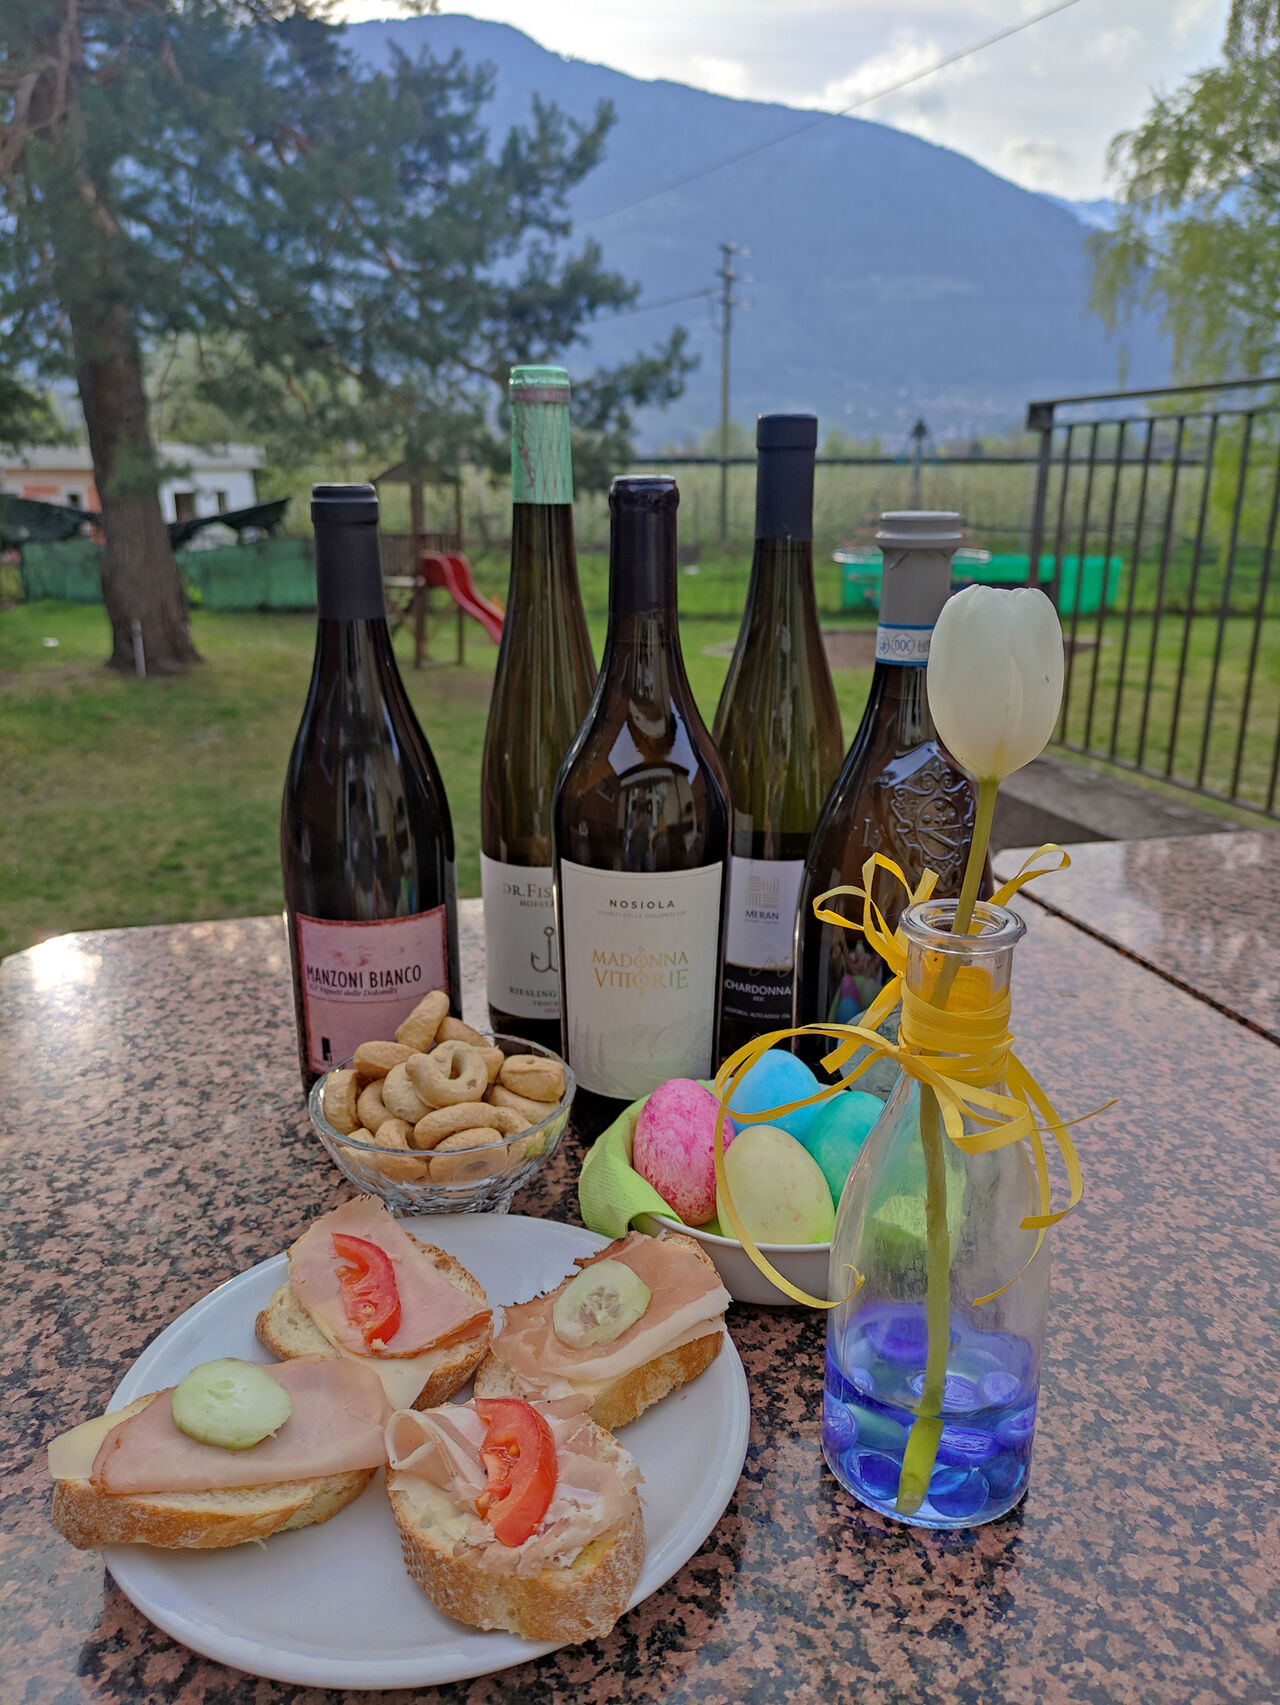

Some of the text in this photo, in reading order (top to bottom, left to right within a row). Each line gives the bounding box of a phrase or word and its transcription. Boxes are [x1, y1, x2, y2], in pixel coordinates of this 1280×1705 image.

[609, 900, 675, 909] NOSIOLA
[745, 910, 779, 920] MERAN
[592, 949, 689, 968] MADONNA
[307, 965, 422, 988] MANZONI BIANCO
[594, 967, 689, 989] VITTORIE
[509, 986, 557, 998] RIESLING
[725, 979, 792, 995] CHARDONNA
